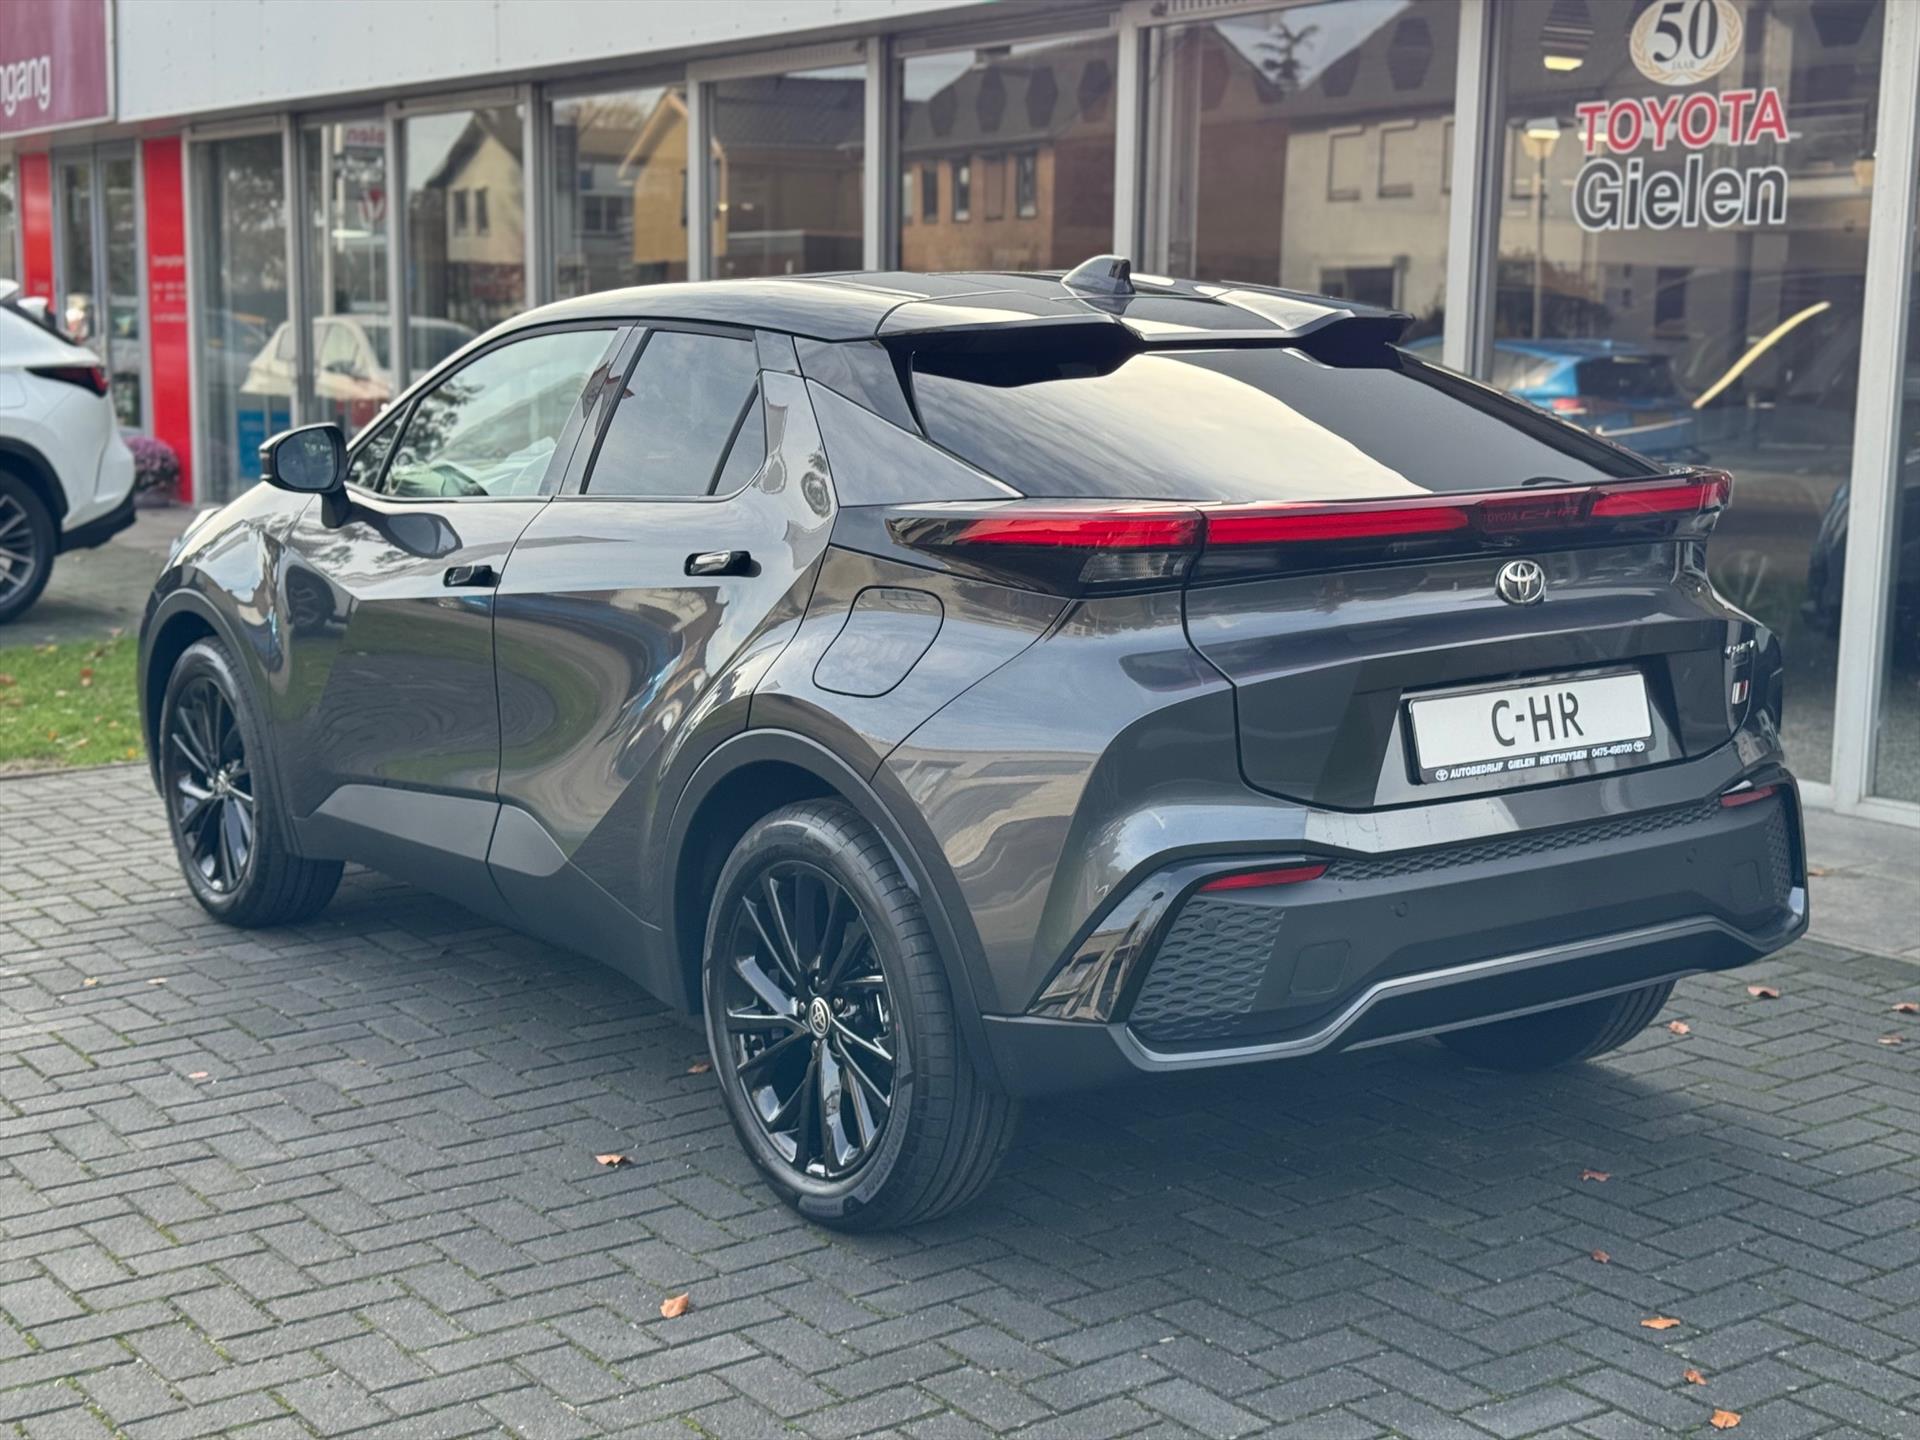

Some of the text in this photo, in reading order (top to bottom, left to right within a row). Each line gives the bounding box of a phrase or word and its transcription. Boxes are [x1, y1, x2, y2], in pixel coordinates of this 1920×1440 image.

[1653, 0, 1719, 62] 50
[1576, 88, 1789, 154] TOYOTA
[1572, 155, 1789, 231] Gielen
[1483, 512, 1517, 522] TOYOTA
[1491, 691, 1584, 747] C-HR
[1449, 761, 1504, 779] AUTOBEDRIJF
[1507, 757, 1536, 770] GIELEN
[1539, 749, 1587, 765] HEYTHUYSEN
